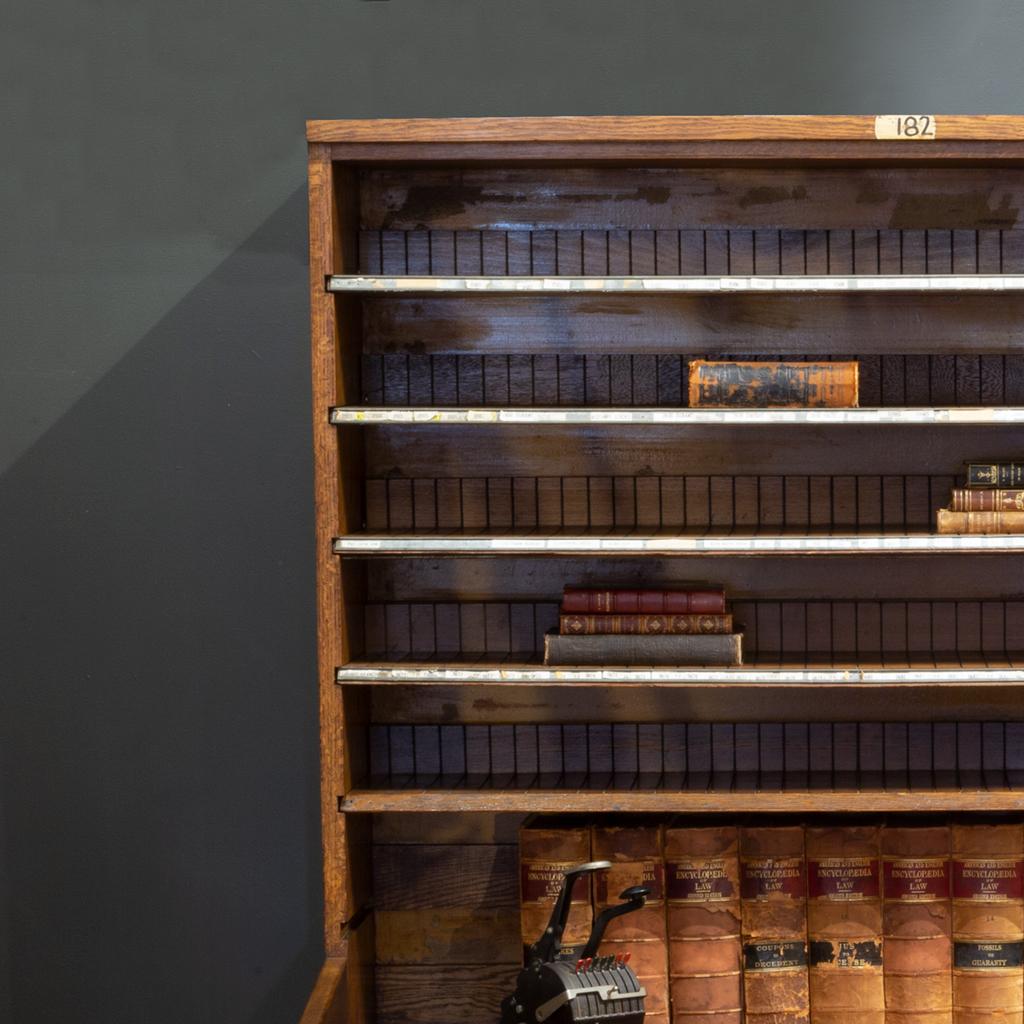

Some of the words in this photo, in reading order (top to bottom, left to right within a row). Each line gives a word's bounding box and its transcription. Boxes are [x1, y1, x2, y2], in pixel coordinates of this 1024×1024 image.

[896, 115, 934, 137] 182
[695, 882, 712, 890] LAW
[764, 882, 783, 890] LAW
[836, 881, 854, 889] LAW
[909, 882, 928, 890] LAW
[980, 882, 1000, 890] LAW
[971, 959, 1008, 967] GUARANTY
